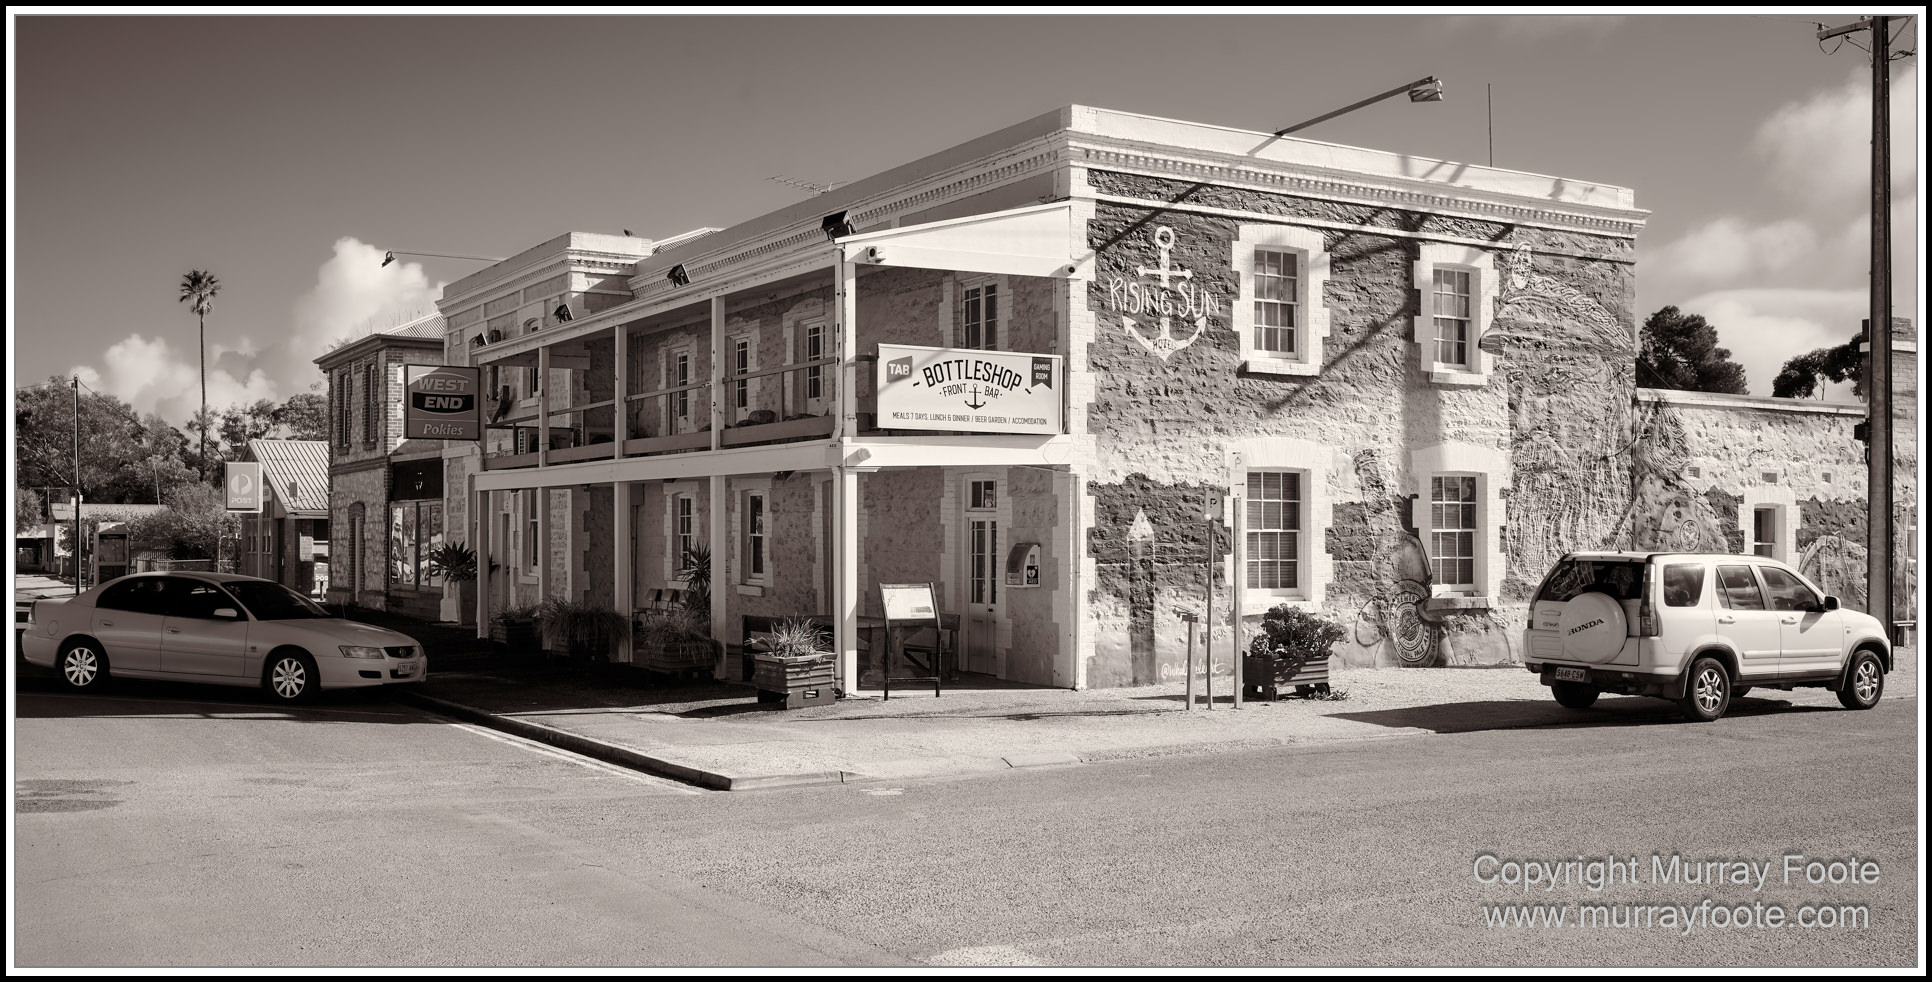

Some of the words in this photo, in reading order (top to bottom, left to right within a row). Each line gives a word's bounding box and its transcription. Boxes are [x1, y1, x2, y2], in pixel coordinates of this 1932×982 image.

[1107, 277, 1173, 316] RISING
[1177, 281, 1220, 318] SUN
[888, 363, 910, 376] TAB
[1033, 363, 1051, 371] GAMING
[922, 359, 1023, 391] BOTTLESHOP
[1035, 372, 1048, 380] ROOM
[418, 378, 469, 391] WEST
[942, 383, 967, 397] FRONT
[984, 385, 1000, 399] BAR
[424, 396, 463, 409] END
[892, 411, 910, 420] MEALS
[929, 413, 947, 421] LUNCH
[952, 414, 970, 423] DINNER
[974, 415, 987, 423] BEER
[987, 416, 1007, 424] GARDEN
[423, 423, 464, 435] Pokies
[1567, 619, 1605, 636] HONDA
